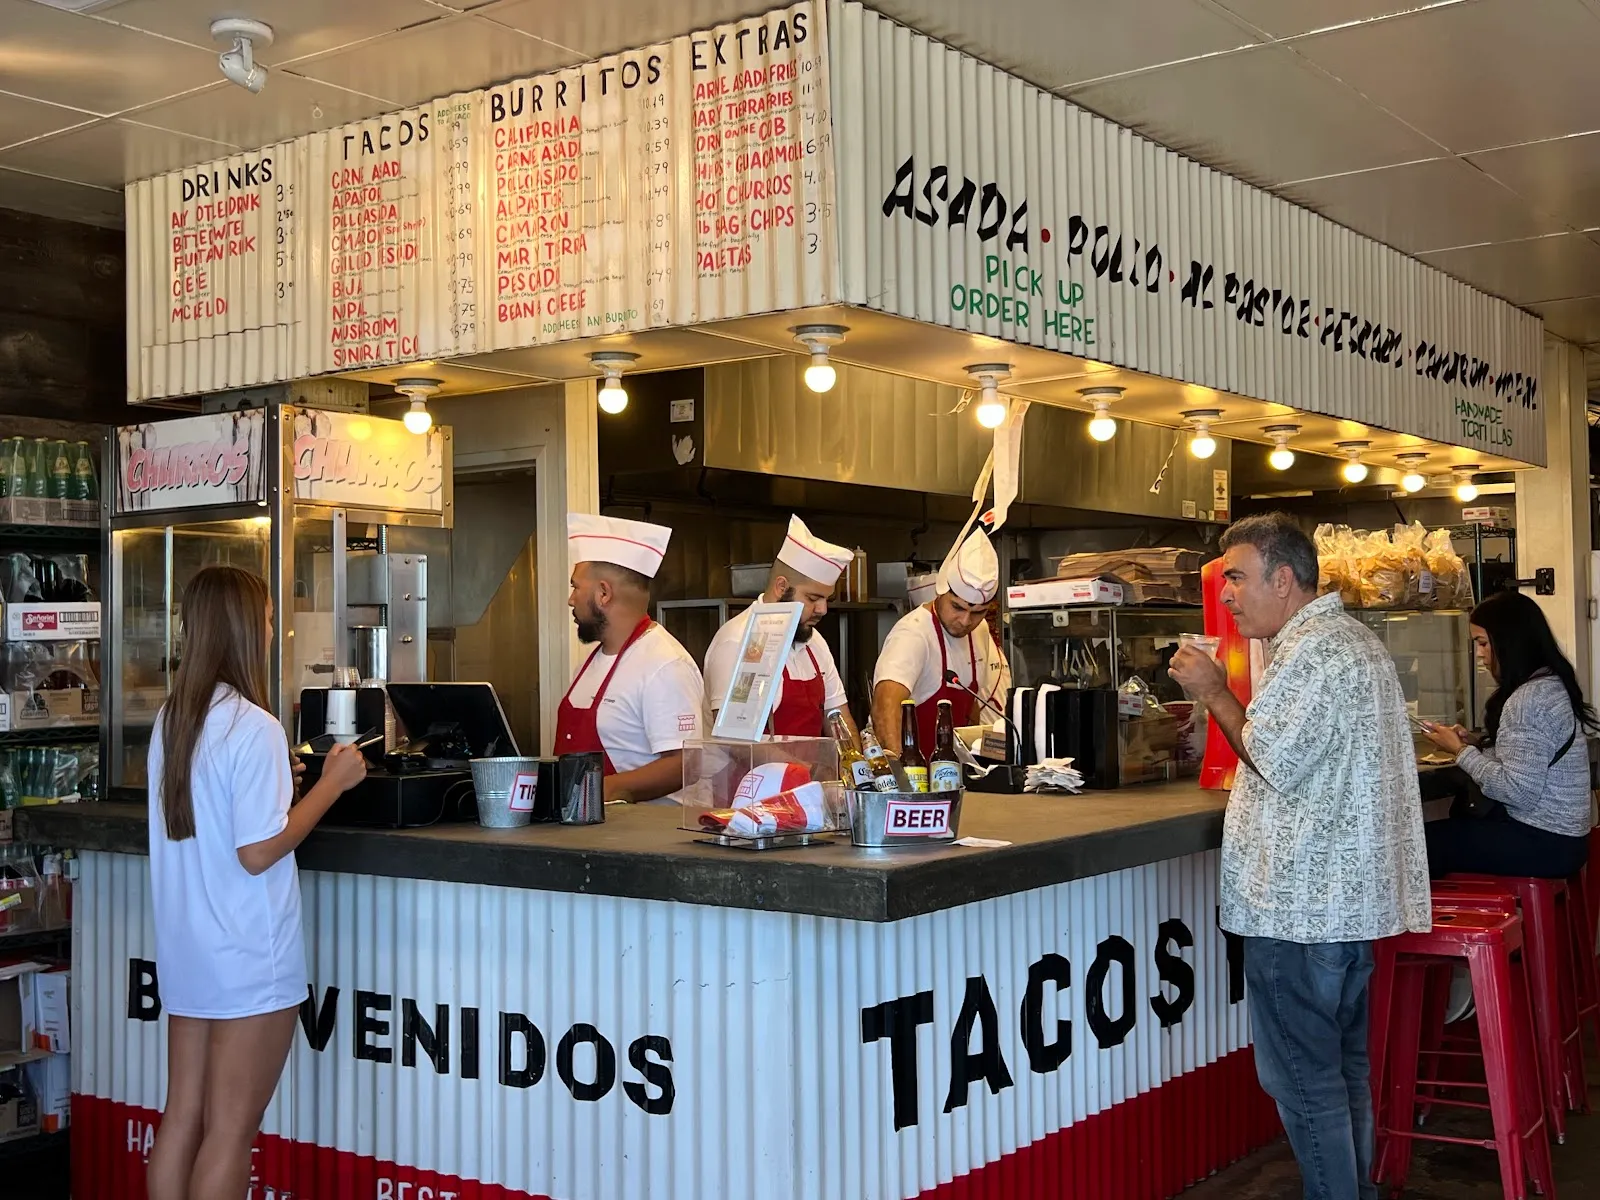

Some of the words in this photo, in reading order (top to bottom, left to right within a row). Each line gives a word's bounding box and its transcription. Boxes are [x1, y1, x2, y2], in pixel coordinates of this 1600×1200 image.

[692, 12, 807, 71] EXTRAS
[491, 55, 662, 123] BURRITOS
[693, 76, 730, 101] ARNE
[733, 68, 768, 93] ASADA
[769, 59, 797, 84] FRIES
[342, 113, 430, 161] TACOS
[541, 141, 582, 161] ASAD
[695, 130, 723, 153] ORN
[759, 117, 786, 141] COB
[182, 158, 272, 202] DRINKS
[695, 158, 724, 181] HIPS
[727, 174, 792, 207] CHURROS
[750, 205, 795, 231] CHIPS
[882, 154, 1029, 255] ASADA
[1181, 260, 1214, 310] AL
[498, 247, 530, 270] MAR
[697, 243, 752, 272] PALETAS
[986, 255, 1044, 298] PICK
[1058, 280, 1085, 308] UP
[951, 284, 1030, 329] ORDER
[1045, 309, 1096, 345] HERE
[126, 437, 251, 494] CHURROS
[292, 433, 444, 494] CHURROS
[877, 777, 898, 791] odelo
[892, 809, 945, 829] BEER
[127, 957, 677, 1116] BVENIDOS
[862, 918, 1195, 1133] TACOS
[376, 1177, 459, 1200] BE
